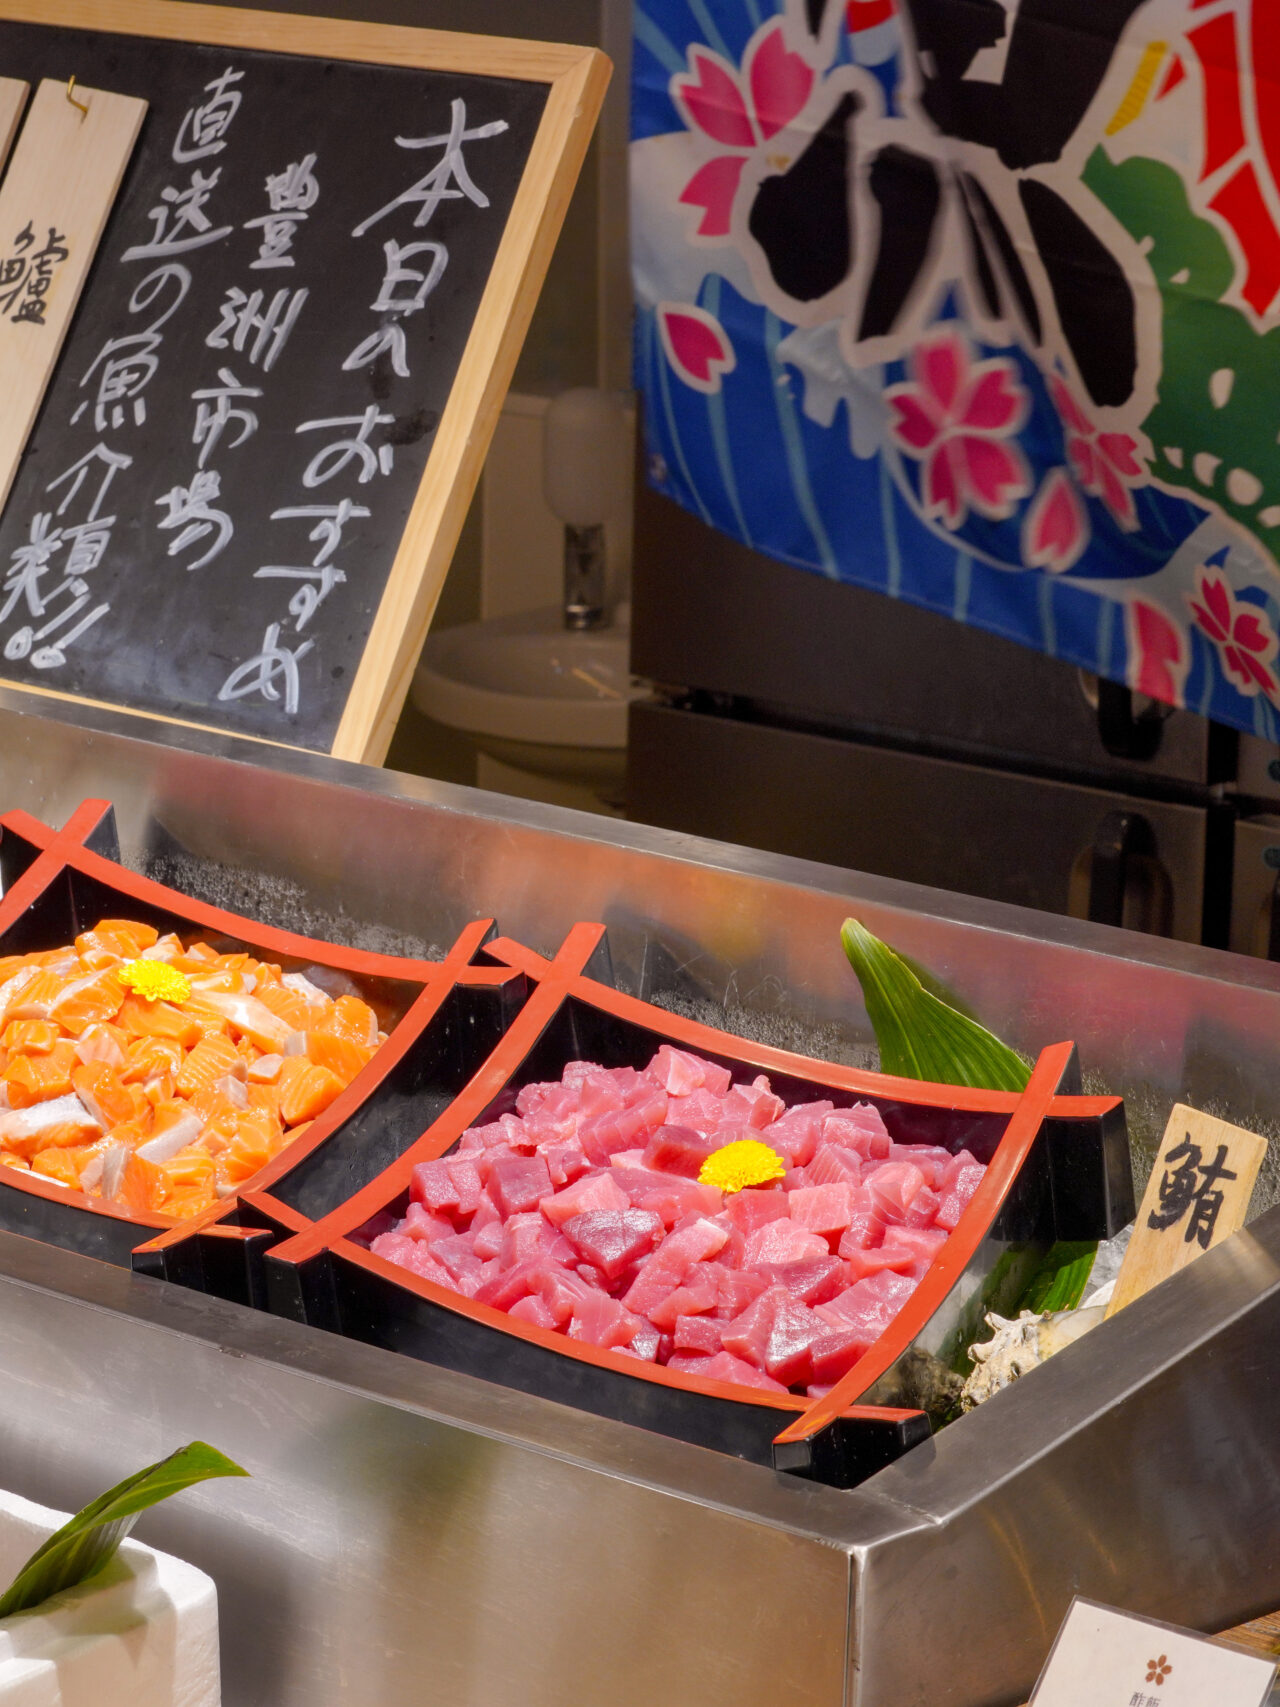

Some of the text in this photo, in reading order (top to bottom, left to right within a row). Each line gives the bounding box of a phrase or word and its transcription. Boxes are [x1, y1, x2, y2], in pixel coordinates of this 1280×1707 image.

[154, 153, 320, 571] 豊洲市場
[218, 98, 510, 714] 本日のおすすめ
[1147, 1131, 1238, 1250] 鮪
